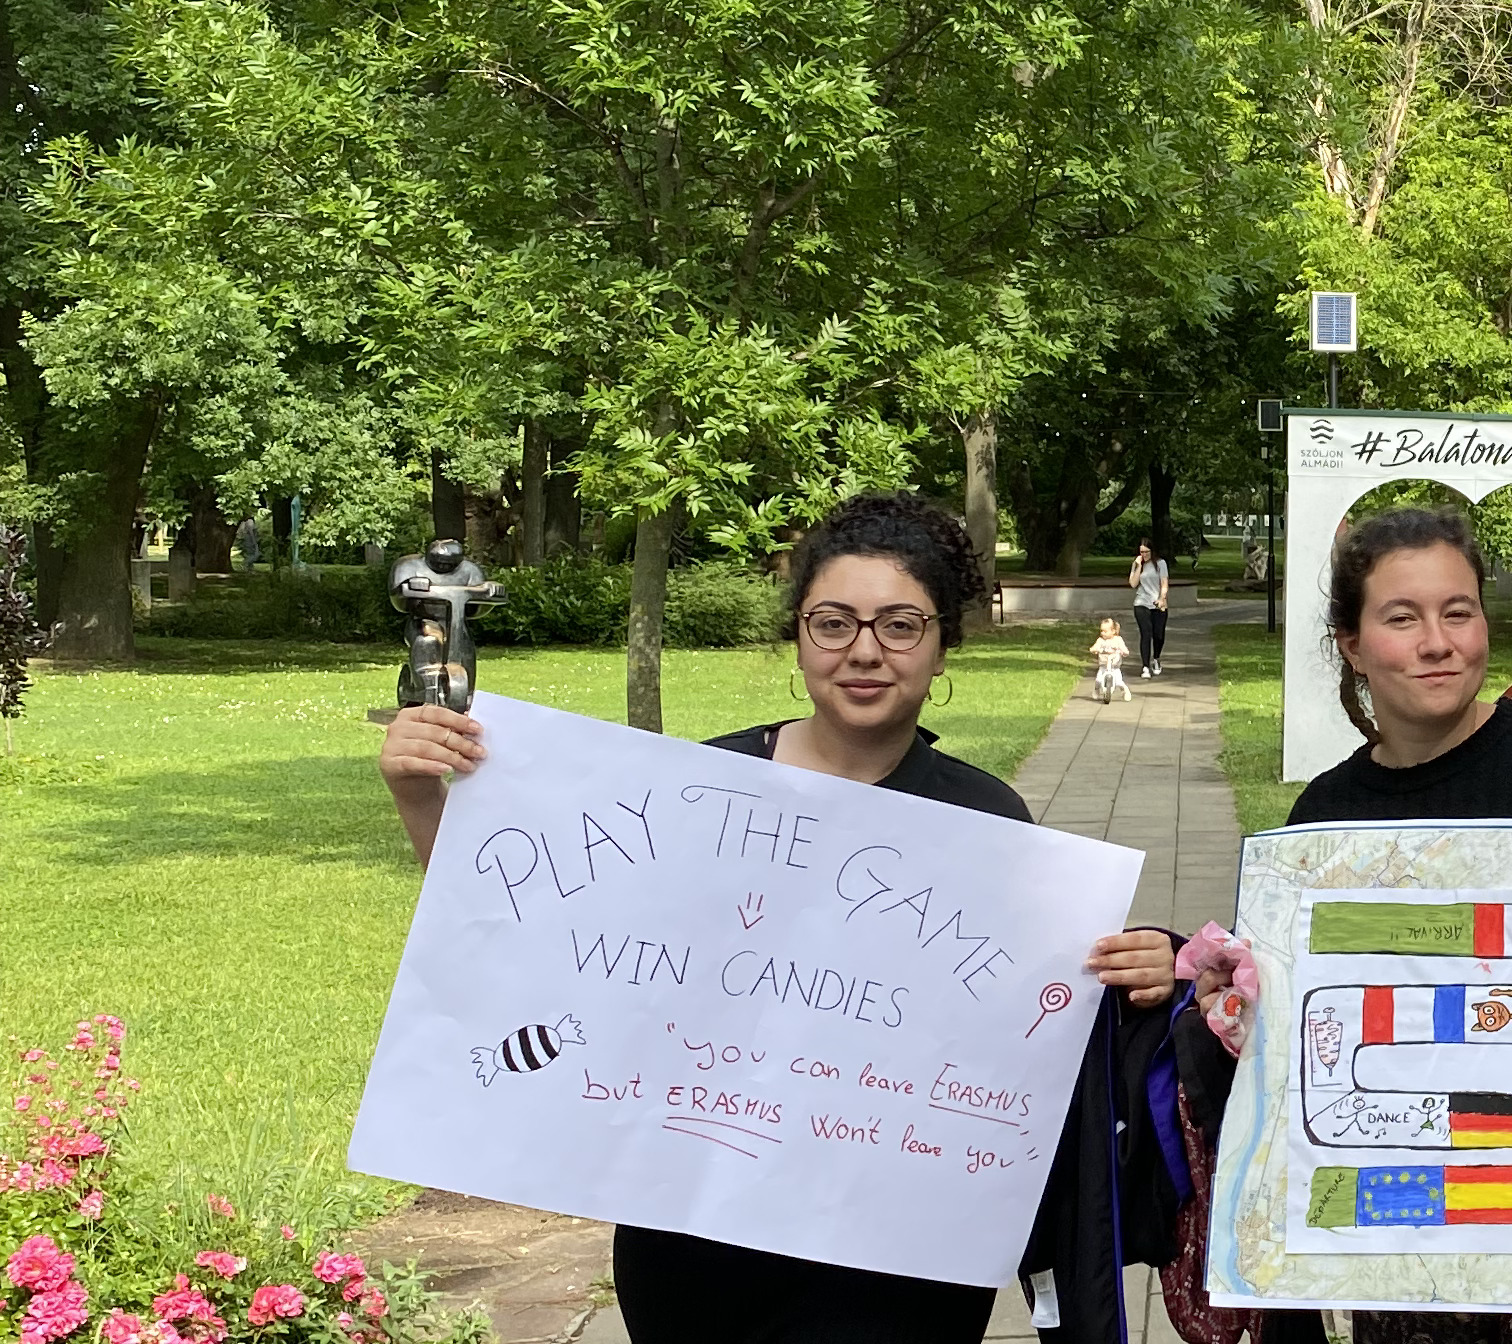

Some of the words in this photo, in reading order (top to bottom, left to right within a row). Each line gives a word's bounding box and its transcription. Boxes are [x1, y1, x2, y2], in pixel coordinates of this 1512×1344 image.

[475, 788, 657, 923] PLAY
[680, 784, 820, 869] THE
[836, 845, 1015, 1003] GAME
[570, 928, 691, 986] WIN
[721, 950, 910, 1028] CANDIES
[581, 1067, 643, 1100] but
[666, 1086, 783, 1123] ERASMUS
[789, 1057, 840, 1079] can
[858, 1062, 914, 1095] leave
[1367, 1112, 1411, 1124] DANCE
[1308, 1171, 1346, 1225] DEPARTURE
